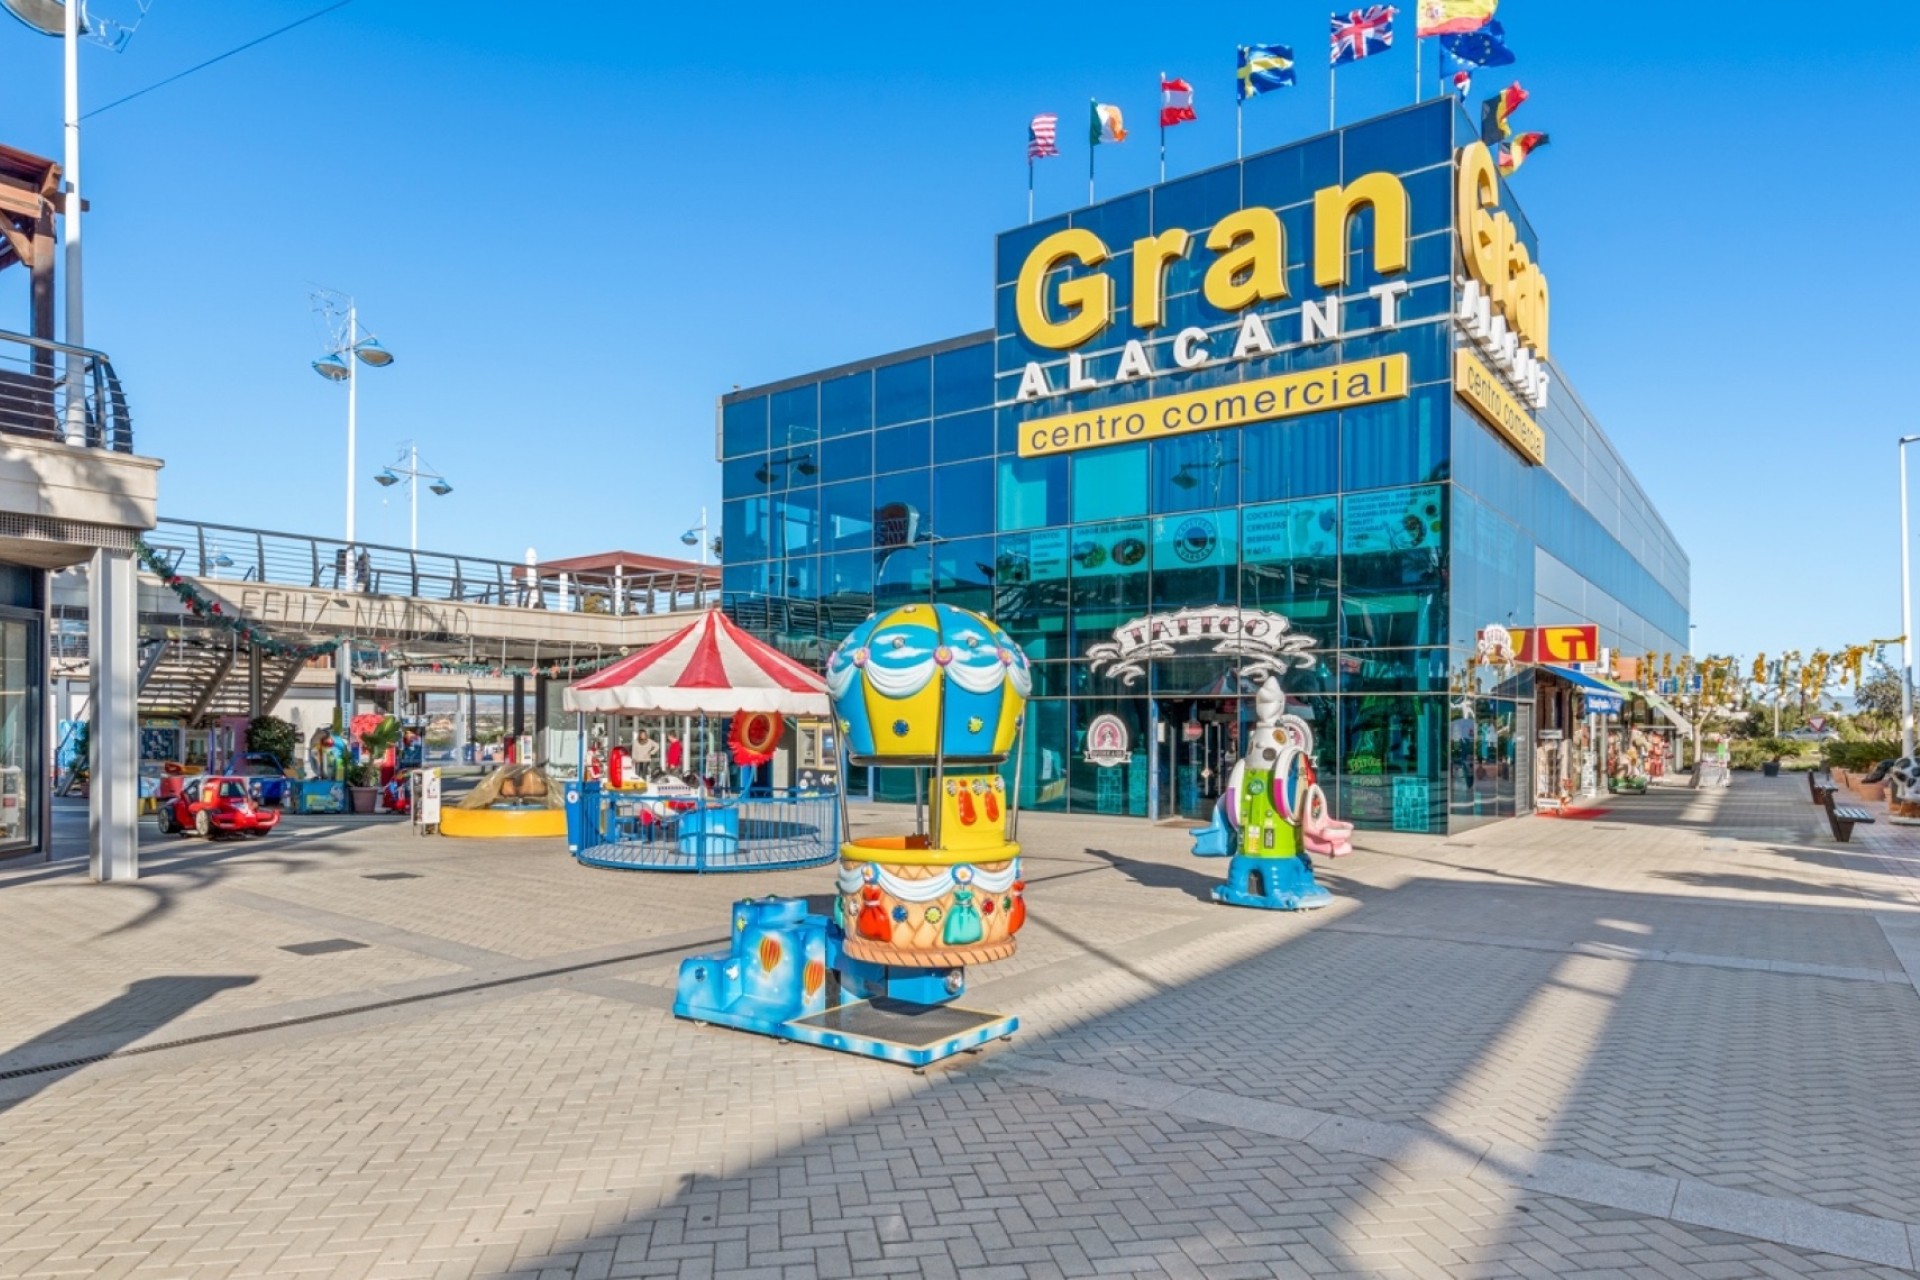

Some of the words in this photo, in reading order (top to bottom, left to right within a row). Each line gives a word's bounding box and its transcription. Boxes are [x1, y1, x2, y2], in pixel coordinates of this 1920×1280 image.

[1015, 171, 1410, 350] Gran
[1016, 280, 1409, 402] ALACANT
[1030, 415, 1146, 451] centro
[1162, 361, 1388, 430] comercial
[1466, 364, 1502, 416] centro
[1503, 402, 1543, 460] comercia
[239, 588, 331, 632] FELIZ
[353, 599, 471, 642] NAVIDAD
[1124, 615, 1270, 645] TATTOO
